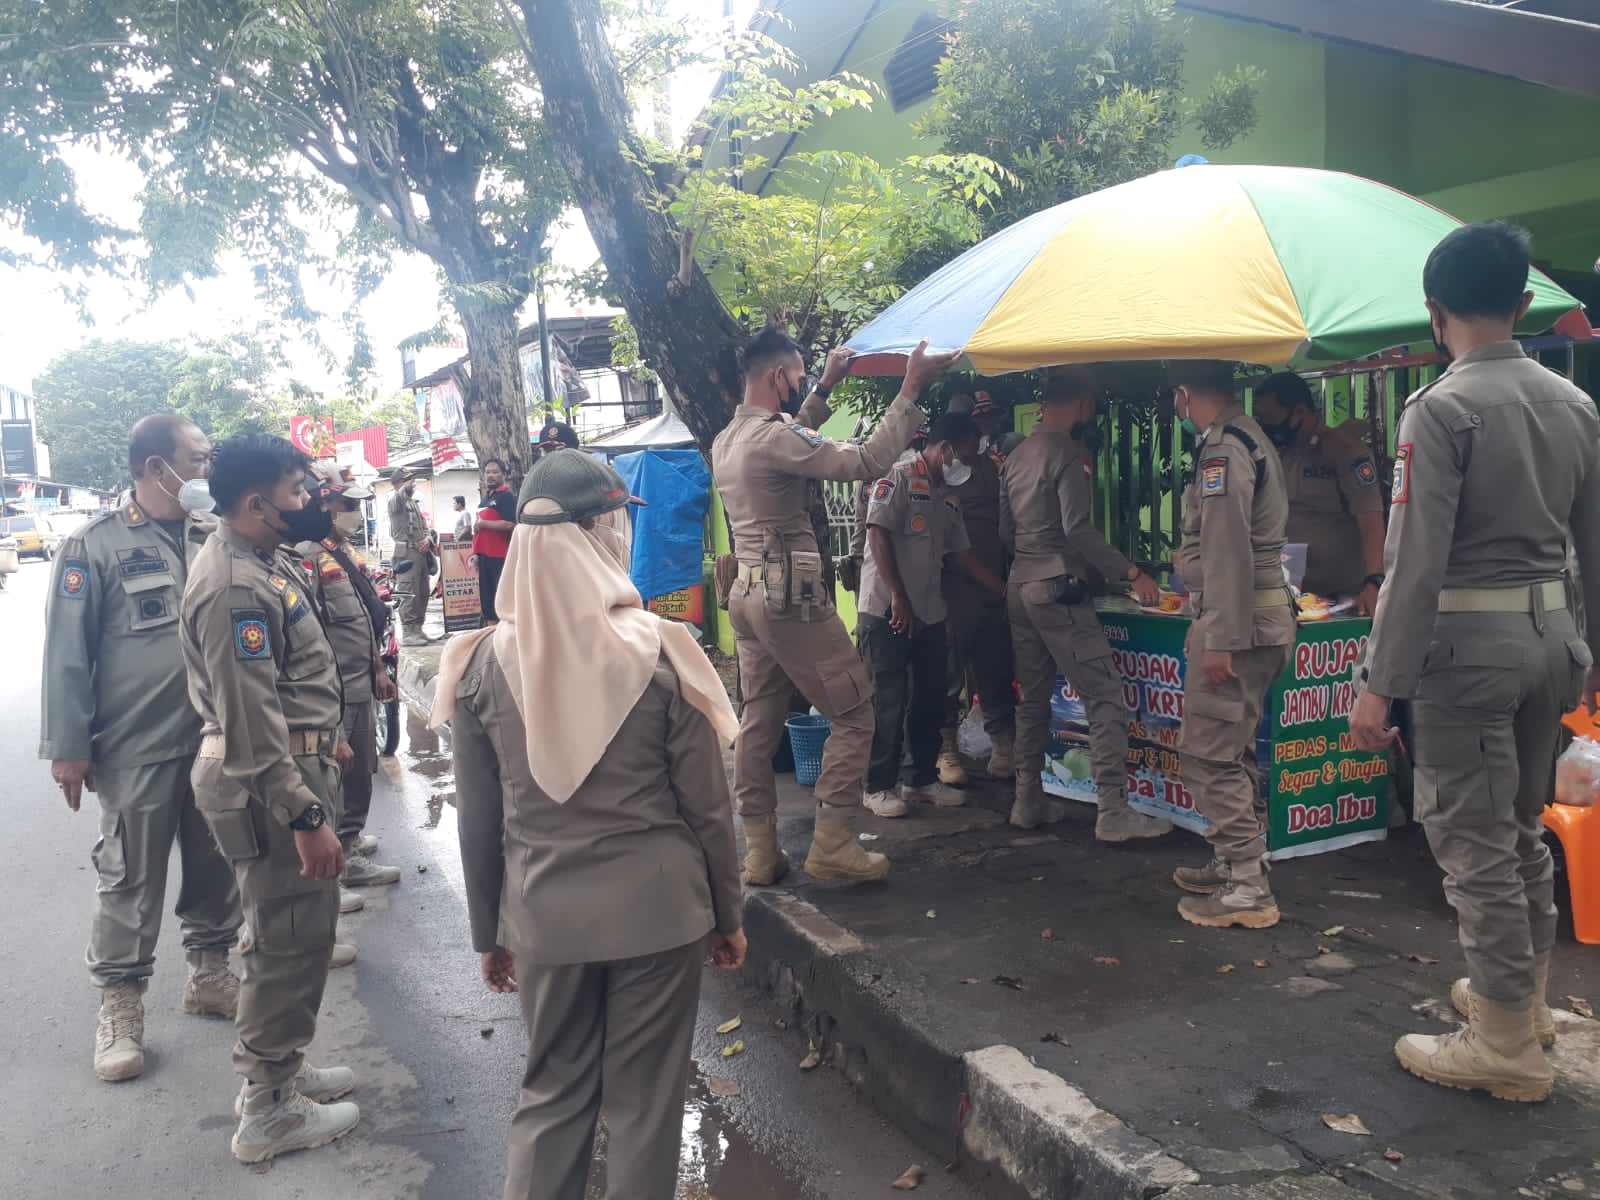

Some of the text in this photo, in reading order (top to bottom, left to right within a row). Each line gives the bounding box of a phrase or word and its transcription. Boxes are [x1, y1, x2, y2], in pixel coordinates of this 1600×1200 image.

[1296, 635, 1369, 680] RUJA
[1280, 685, 1329, 727] JAMBU
[1275, 736, 1327, 764] PEDAS
[1278, 755, 1387, 796] Segar & Dingin
[1288, 792, 1376, 834] Doa Ibu
